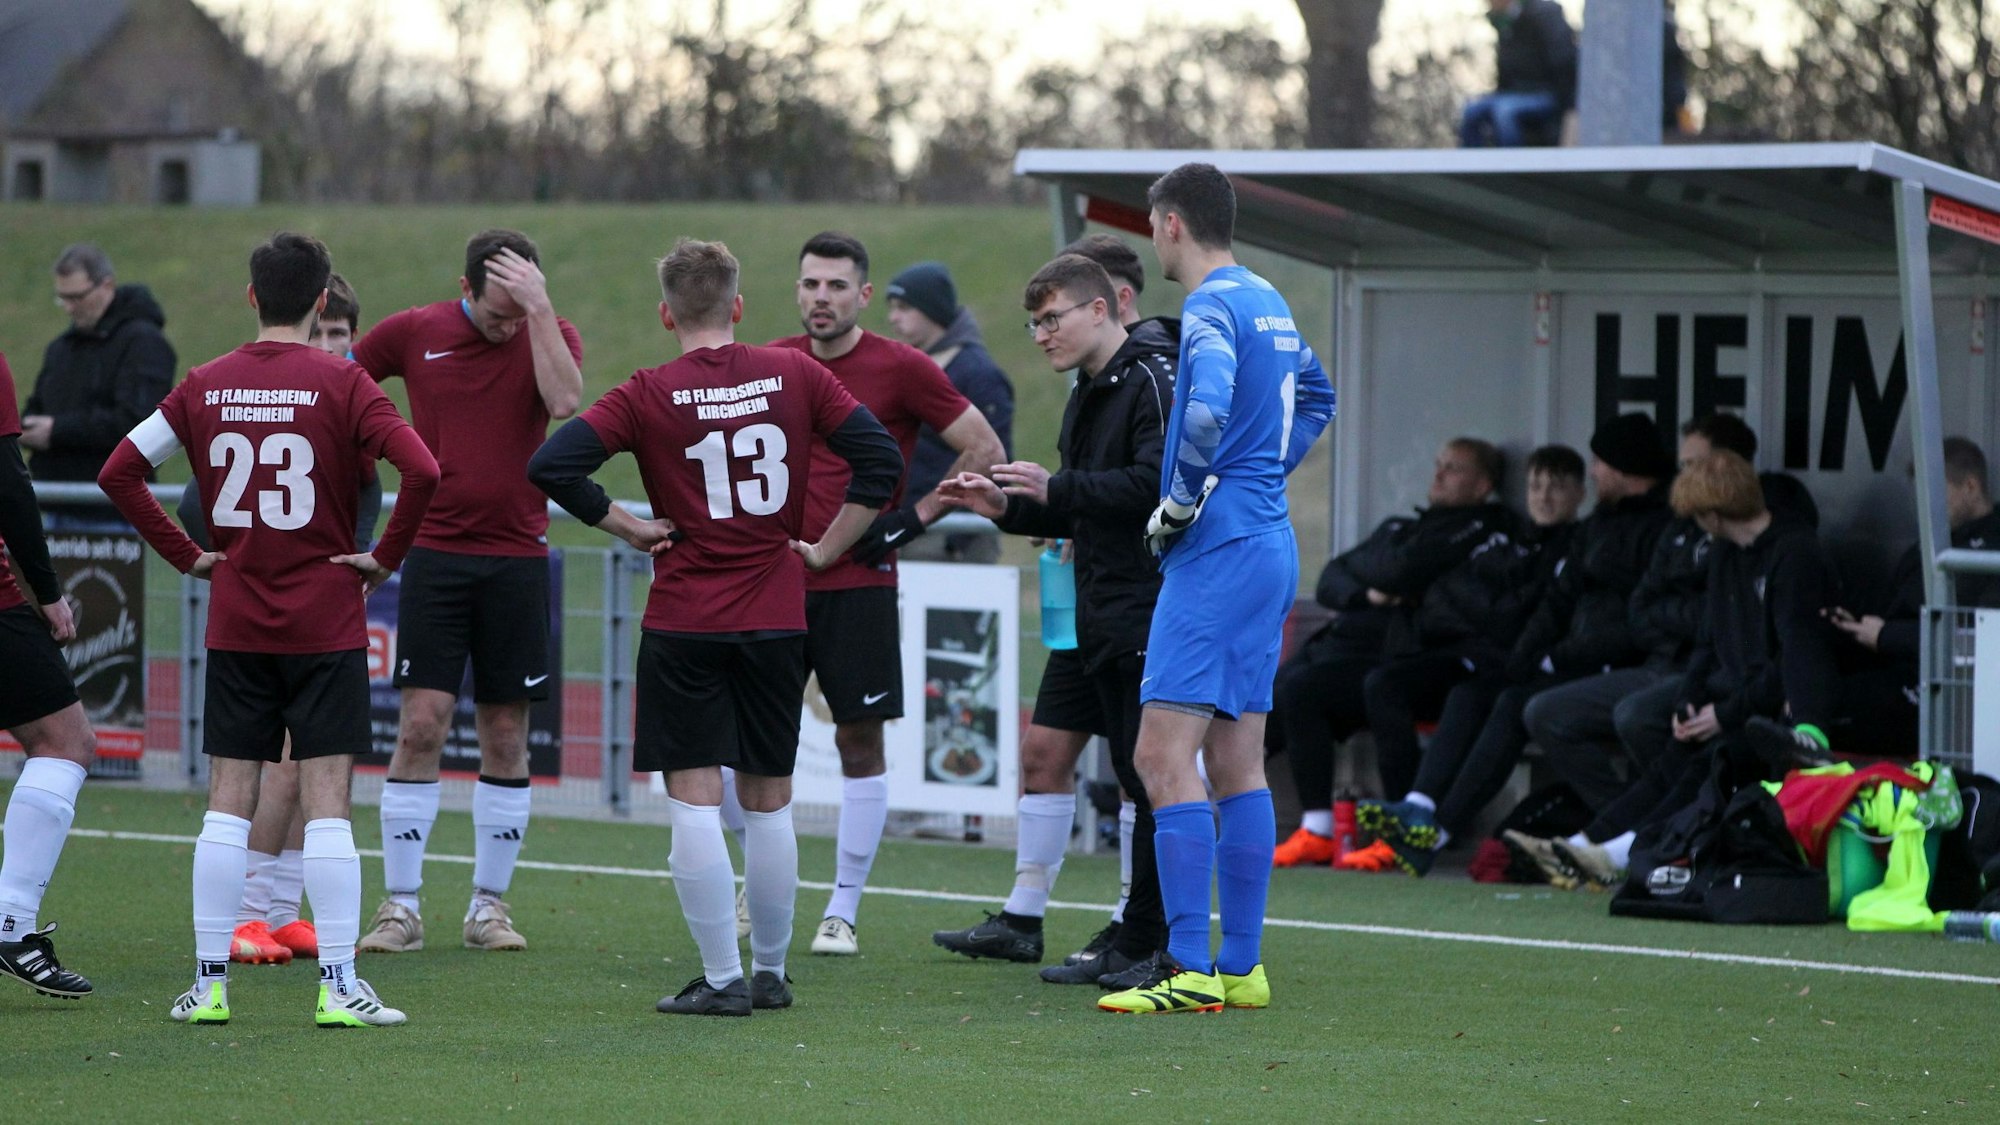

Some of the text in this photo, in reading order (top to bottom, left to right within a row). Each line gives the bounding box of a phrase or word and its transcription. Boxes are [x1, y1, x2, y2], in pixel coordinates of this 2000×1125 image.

[1254, 316, 1270, 333] SG
[205, 388, 320, 407] SG FLAMERSHEIM/
[672, 375, 783, 405] SG FLAMERSHEIM/
[1596, 313, 1909, 473] HEIM
[221, 406, 295, 423] KIRCHHEIM
[697, 396, 770, 420] KIRCHHEIM
[1278, 371, 1296, 462] 1
[209, 432, 316, 531] 23
[684, 423, 790, 520] 13
[400, 659, 410, 676] 2
